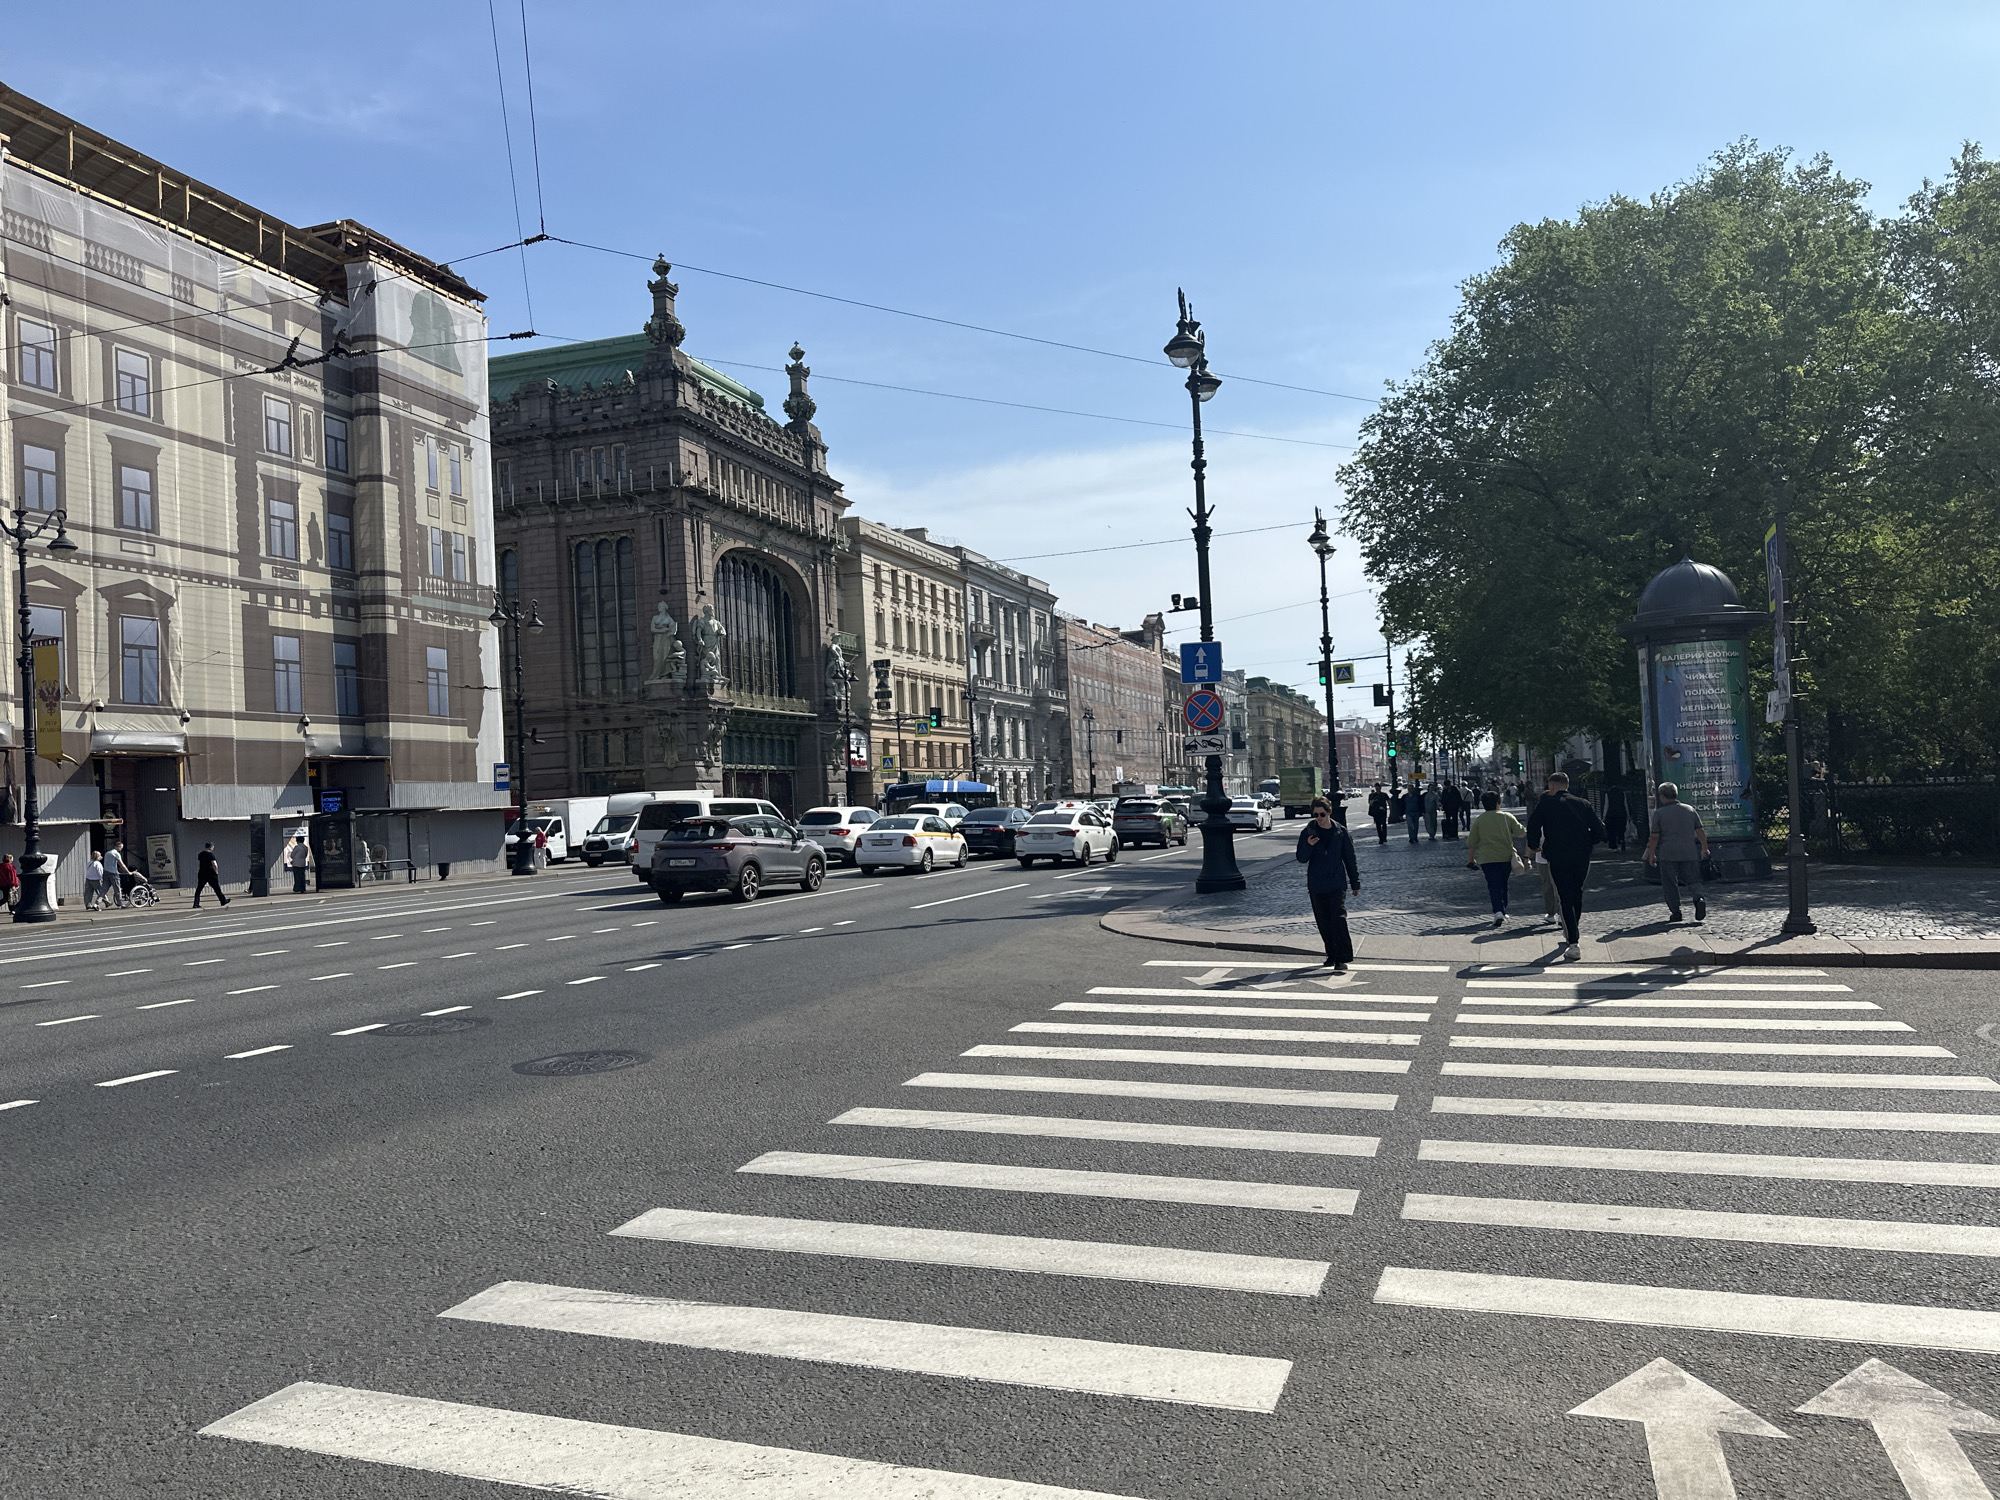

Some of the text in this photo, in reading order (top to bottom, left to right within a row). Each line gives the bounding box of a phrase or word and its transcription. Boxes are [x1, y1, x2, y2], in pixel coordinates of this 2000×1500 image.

[1661, 650, 1740, 662] ВАЛЕРИЙ СЮТКИН
[1684, 688, 1726, 697] ПОЛЮСА
[1680, 703, 1732, 712] МЕЛЬНИЦА
[1676, 718, 1737, 728] КРЕМАТОРИЙ
[1674, 733, 1740, 744] ТАНЦЫ МИНУС
[1693, 750, 1727, 758] ПИЛОТ
[1695, 765, 1727, 774] КНЯZZ
[1679, 780, 1742, 790] НЕЙРОМОНАХ
[1691, 789, 1733, 797] ФЕОФАН
[1712, 802, 1741, 811] PRIVET
